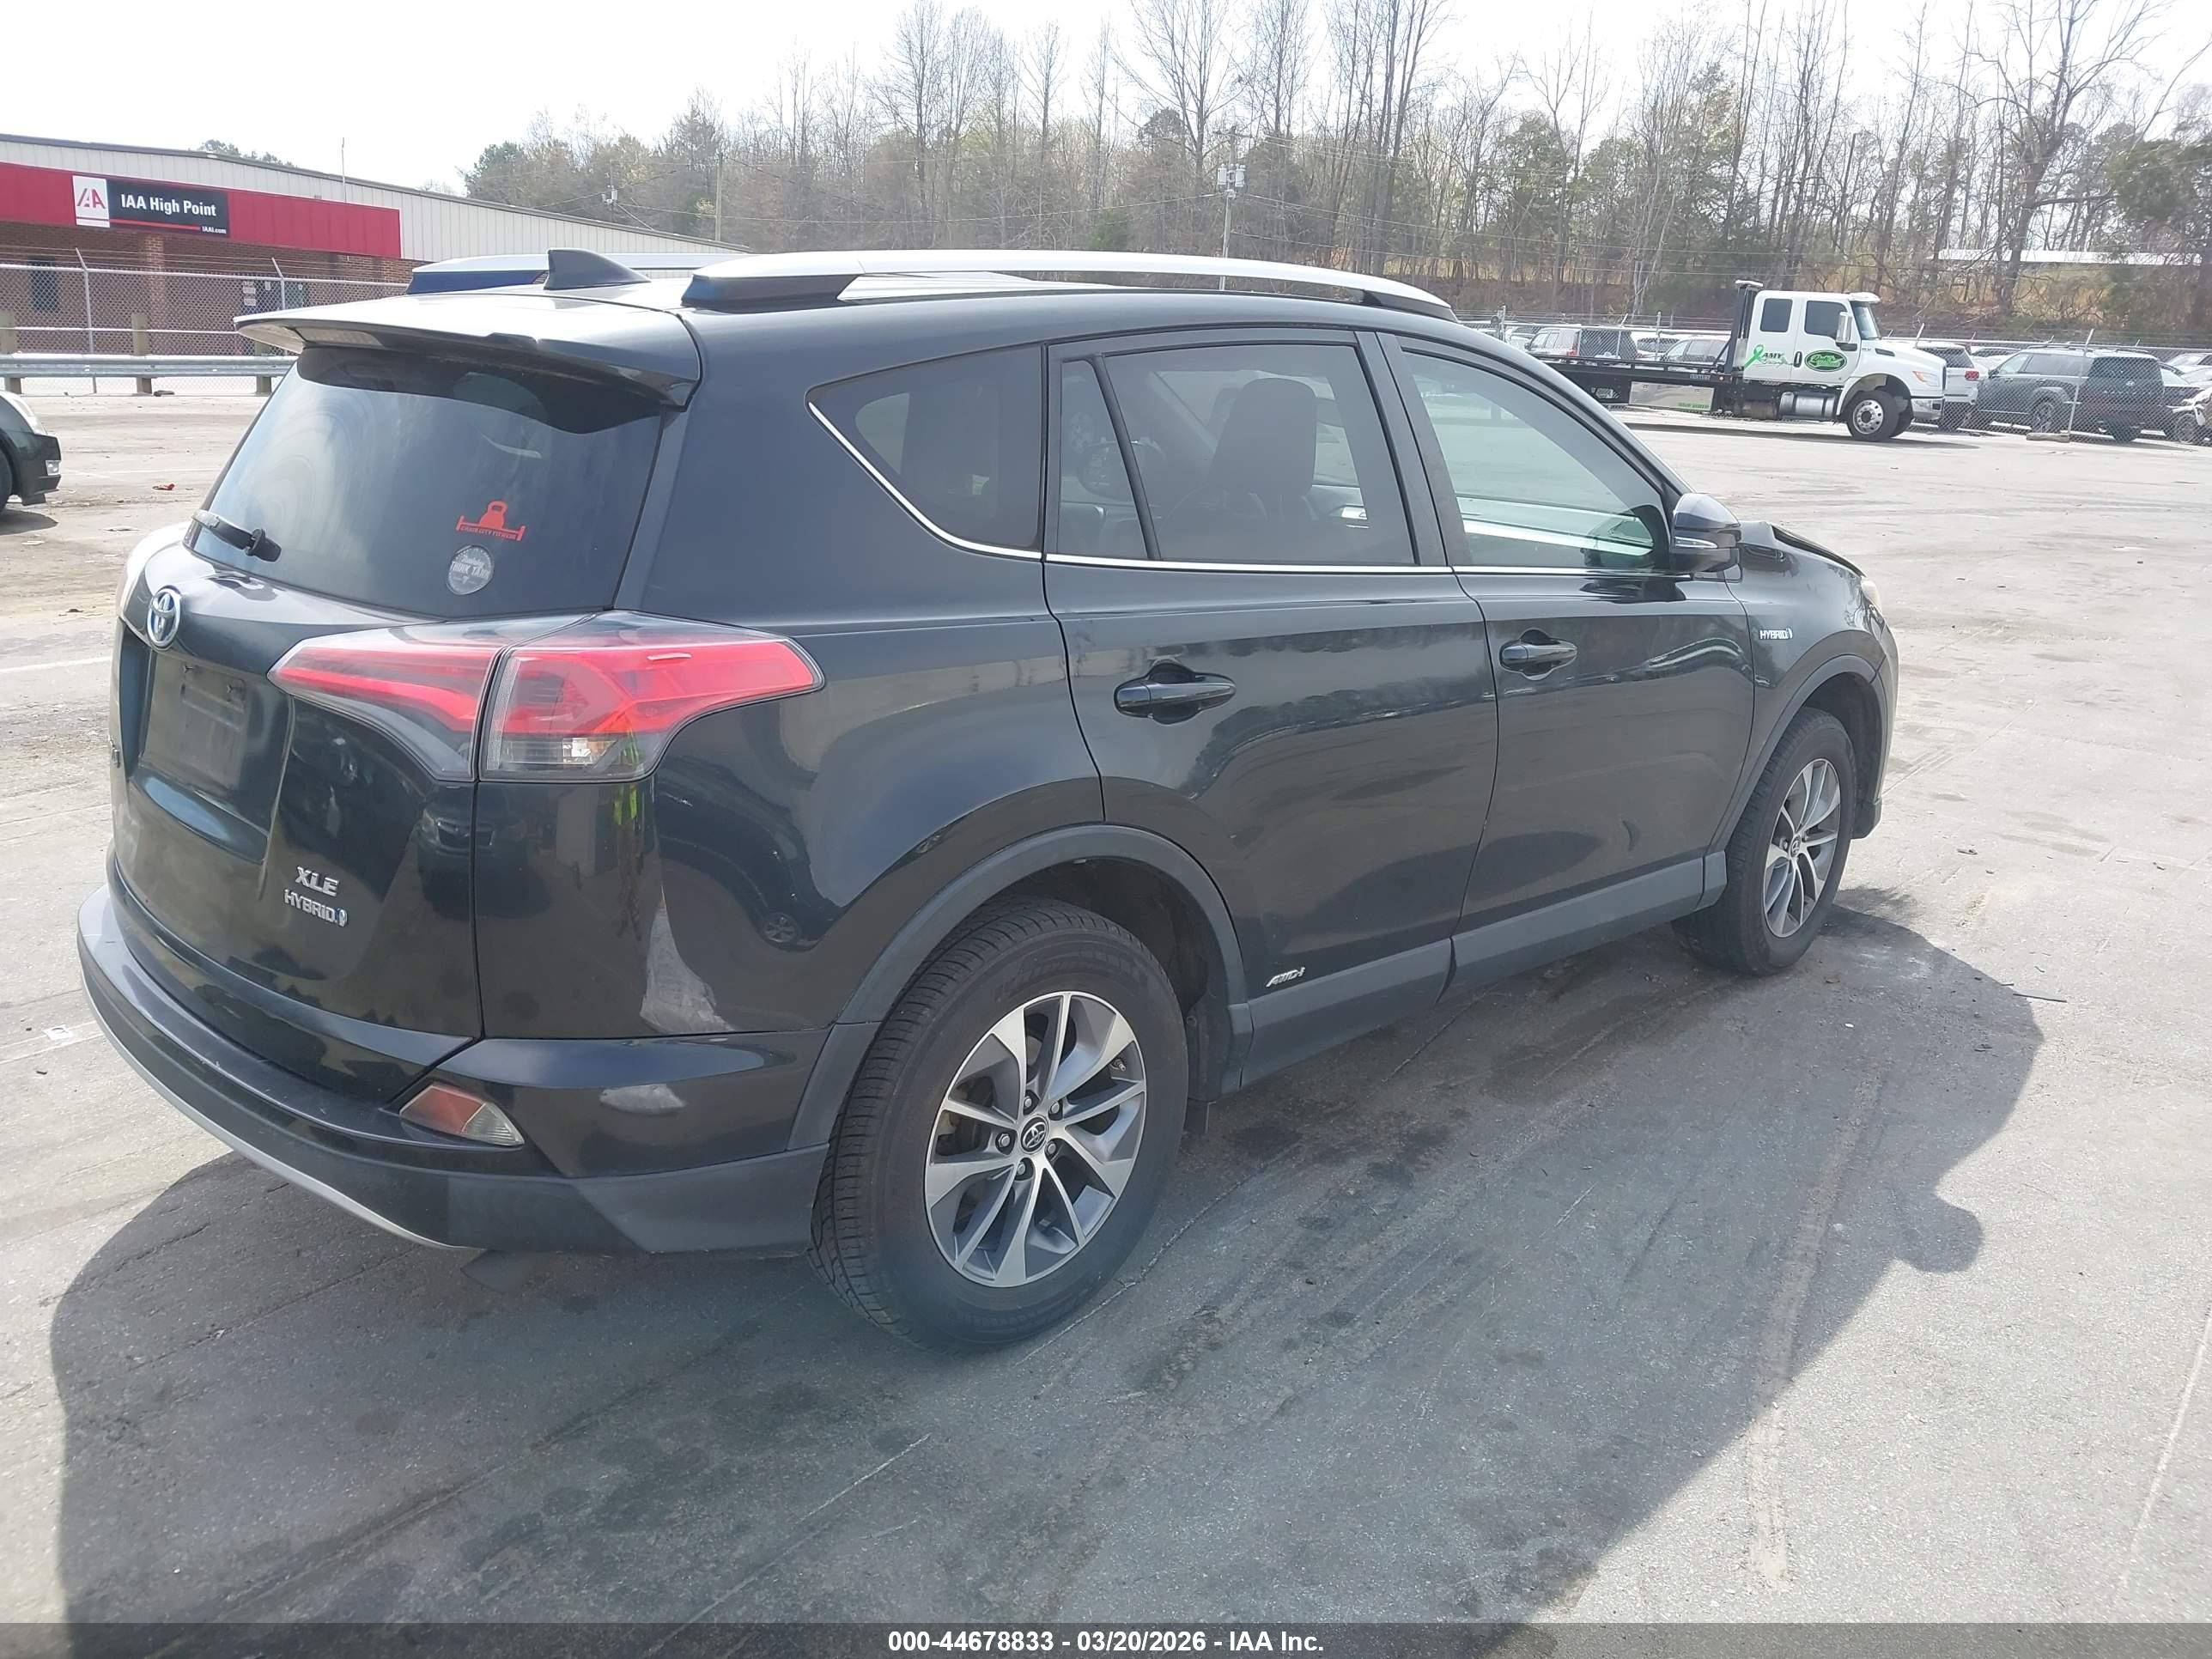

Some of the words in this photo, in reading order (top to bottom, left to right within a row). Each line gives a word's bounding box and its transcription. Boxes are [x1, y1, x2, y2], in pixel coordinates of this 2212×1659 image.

[120, 193, 147, 210] IAA
[149, 197, 180, 216] High
[183, 200, 216, 216] Point
[1759, 629, 1787, 640] HYBRID
[295, 866, 338, 897] XLE
[284, 889, 336, 923] HYBRID
